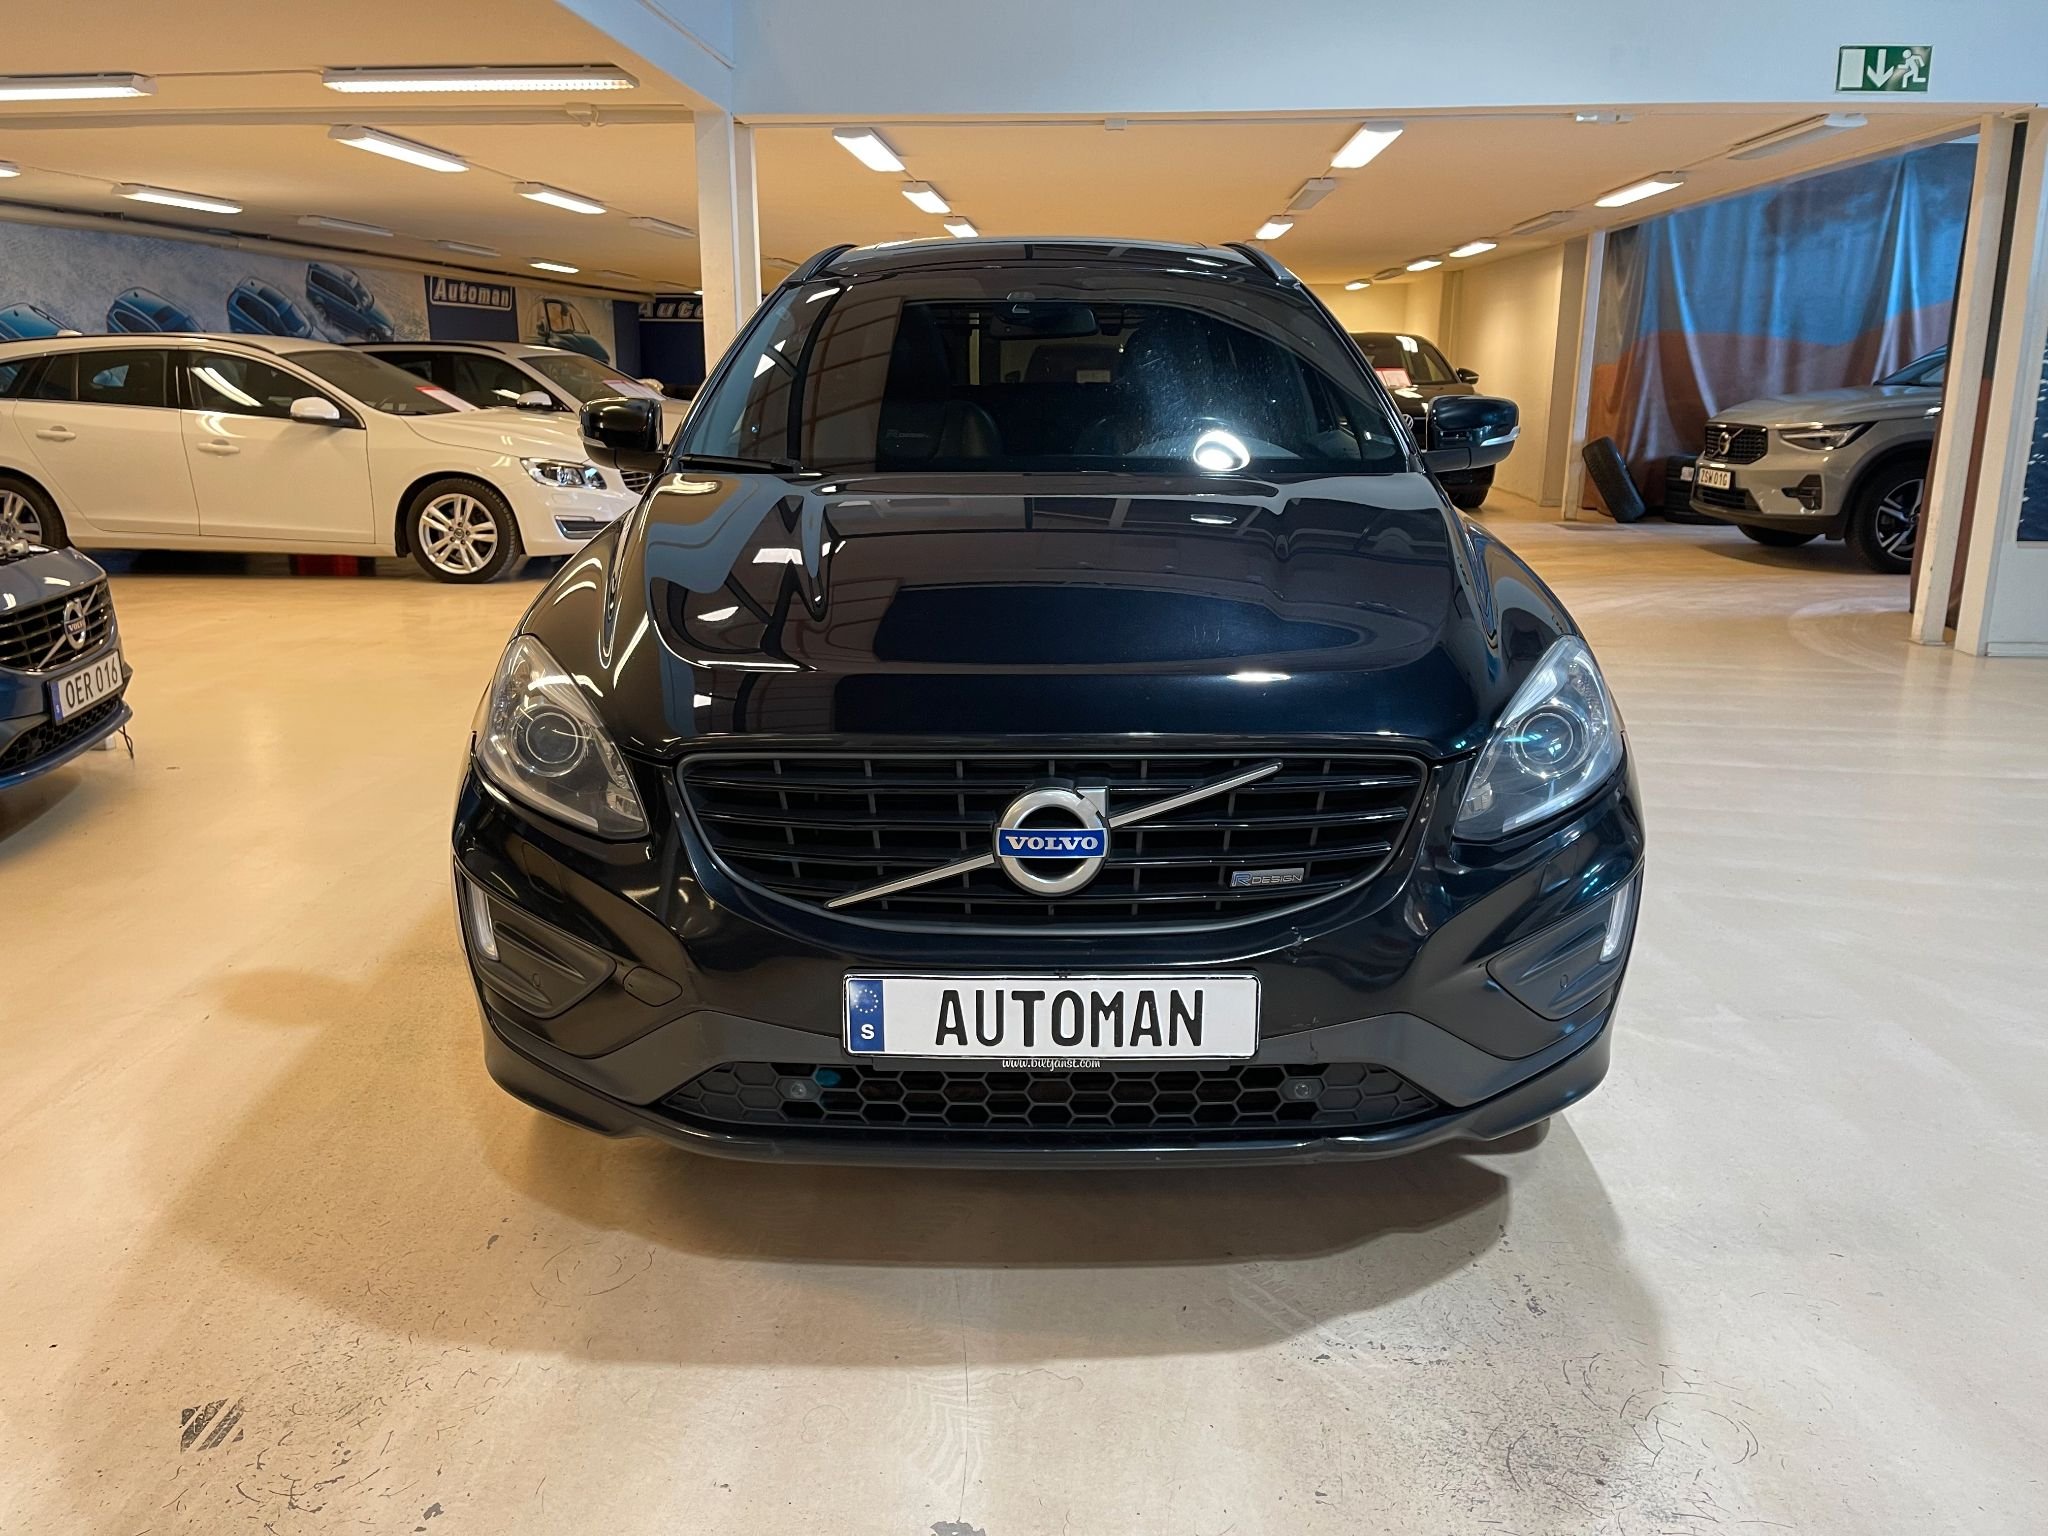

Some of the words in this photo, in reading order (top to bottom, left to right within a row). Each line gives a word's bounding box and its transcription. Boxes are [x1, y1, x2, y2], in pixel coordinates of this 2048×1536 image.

[433, 278, 510, 307] Automan
[65, 671, 94, 709] OER
[95, 656, 118, 692] 016
[1005, 836, 1099, 850] VOLVO
[860, 1023, 875, 1040] S
[934, 989, 1204, 1047] AUTOMAN
